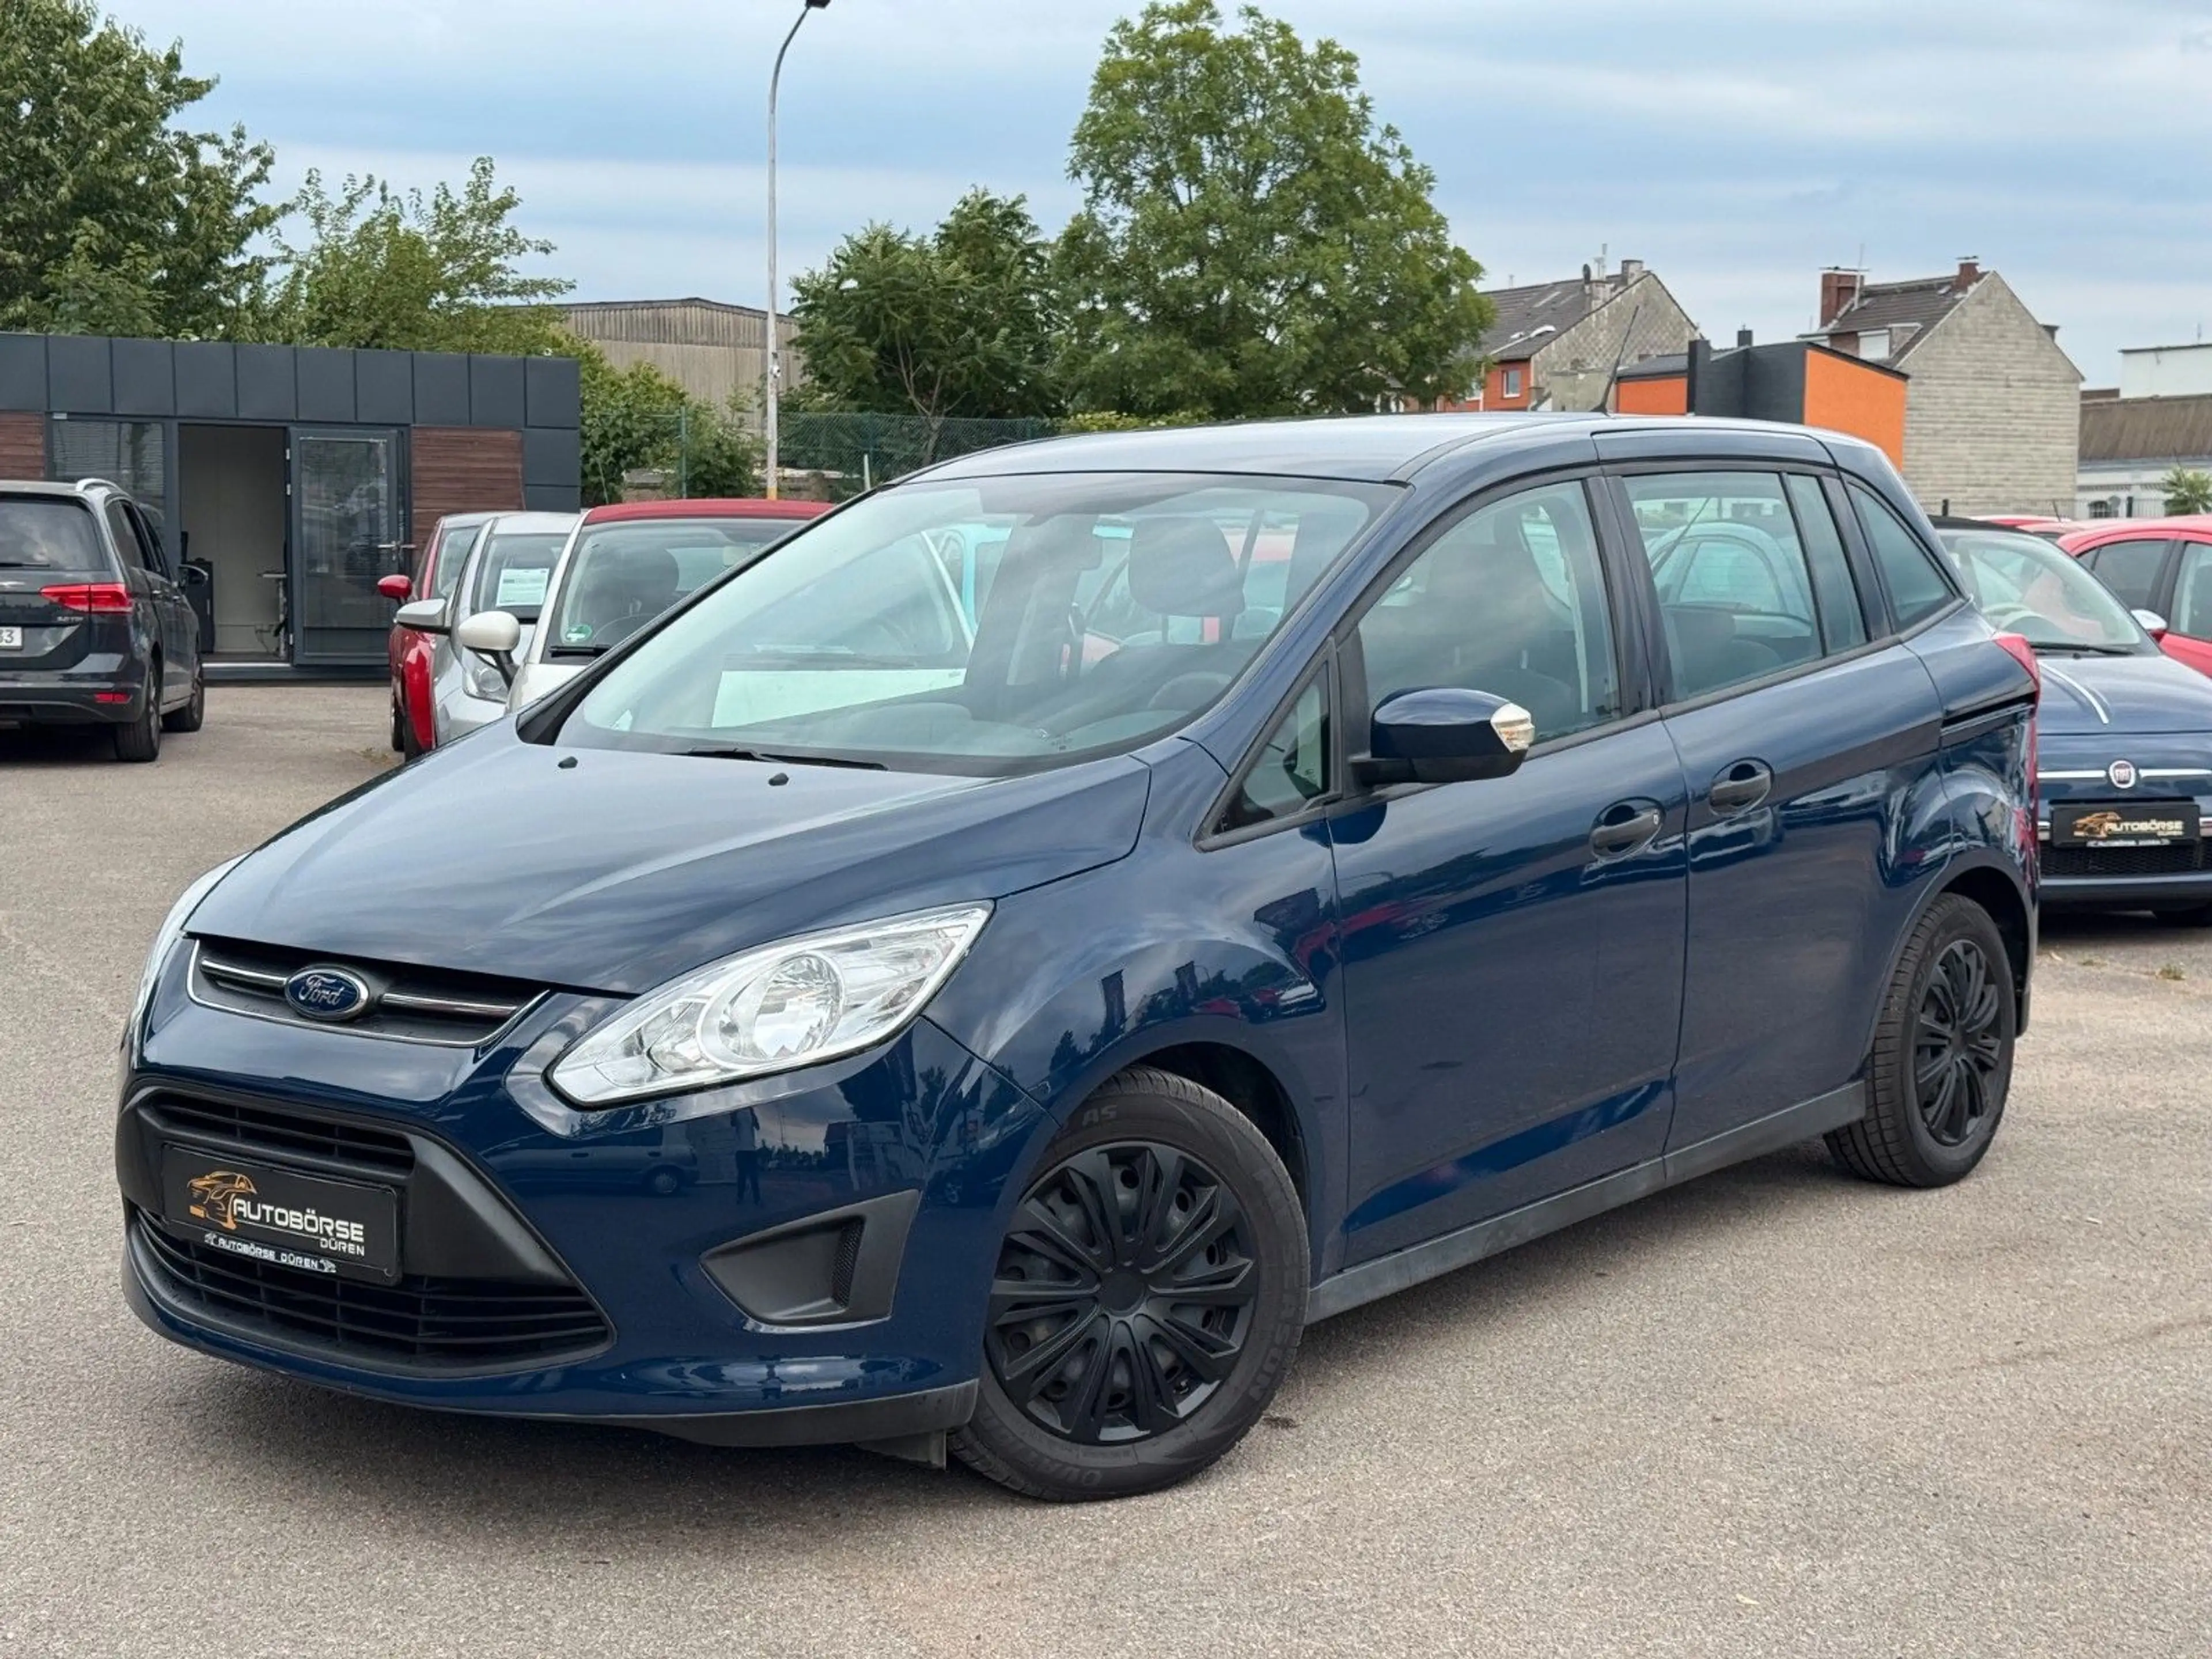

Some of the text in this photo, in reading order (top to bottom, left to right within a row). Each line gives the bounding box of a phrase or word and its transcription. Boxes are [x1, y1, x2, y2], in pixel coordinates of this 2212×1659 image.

[298, 974, 346, 1006] Ford
[1081, 1104, 1119, 1127] AS
[233, 1198, 365, 1243] AUTOBÖRSE
[218, 1238, 319, 1269] AUTOBÖRSE DÜREN
[319, 1237, 365, 1256] DÜREN
